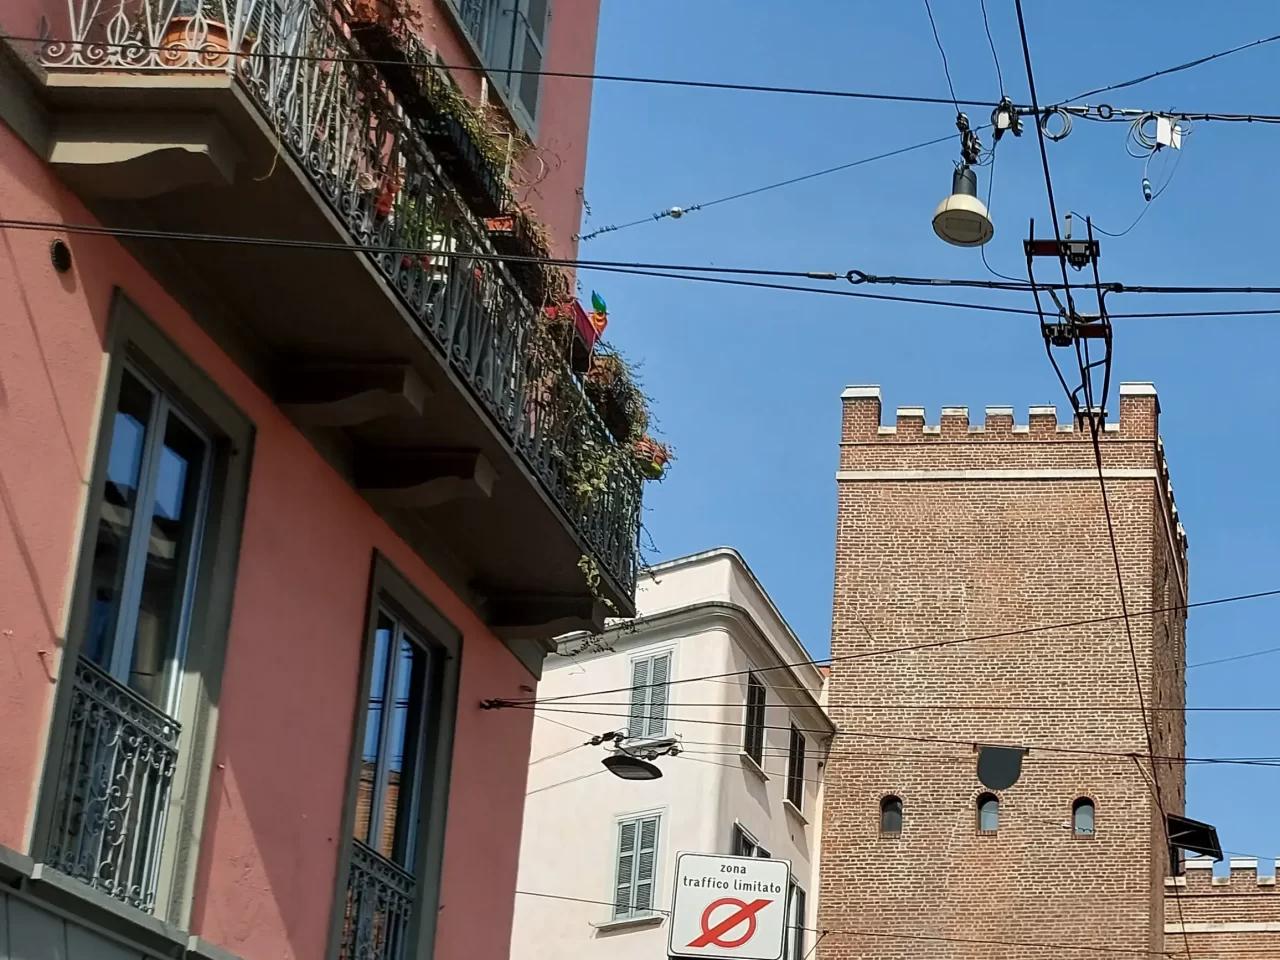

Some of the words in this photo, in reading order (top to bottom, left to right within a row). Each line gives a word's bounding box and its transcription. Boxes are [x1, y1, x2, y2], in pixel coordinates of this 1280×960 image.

[720, 864, 747, 874] zona
[683, 876, 729, 889] traffico
[733, 879, 782, 894] limitato
